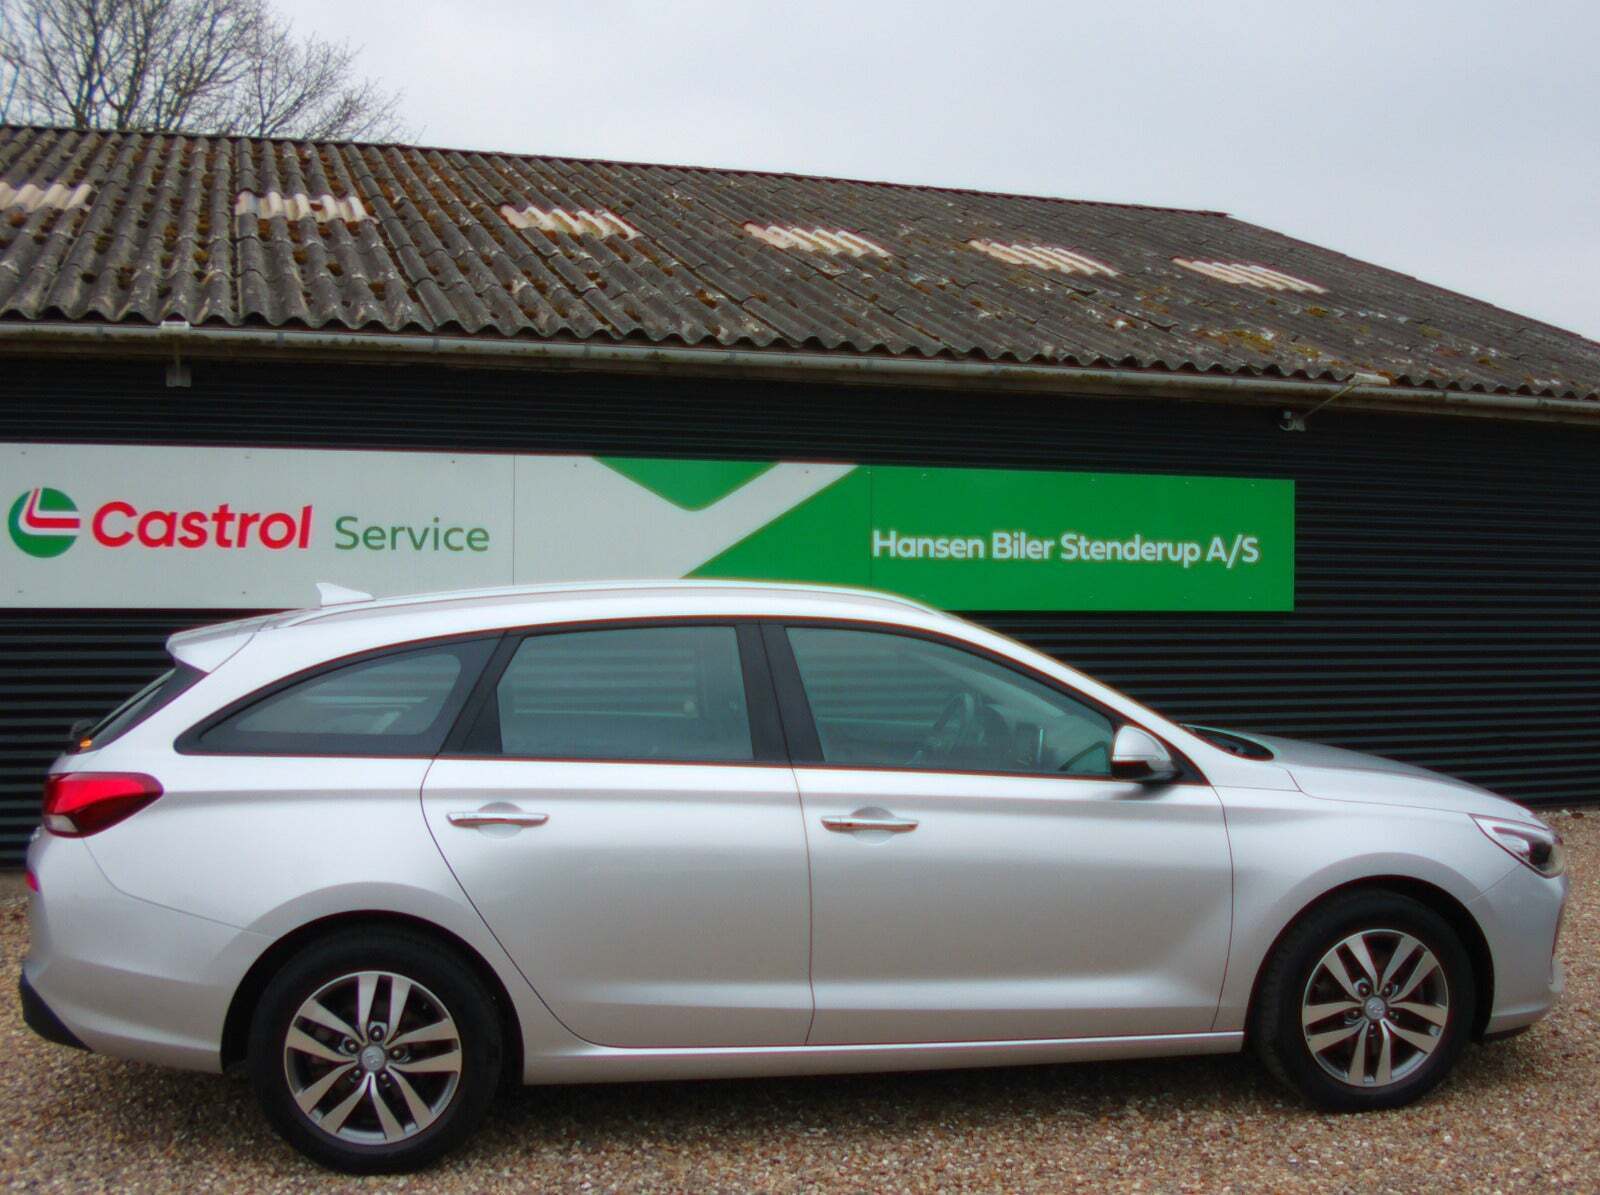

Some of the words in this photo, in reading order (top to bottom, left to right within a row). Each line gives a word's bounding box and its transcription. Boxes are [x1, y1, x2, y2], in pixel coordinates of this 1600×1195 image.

[92, 501, 313, 550] Castrol
[334, 516, 490, 552] Service
[872, 530, 985, 559] Hansen
[991, 531, 1055, 560] Biler
[1060, 533, 1201, 567] Stenderup
[1206, 536, 1260, 568] A/S
